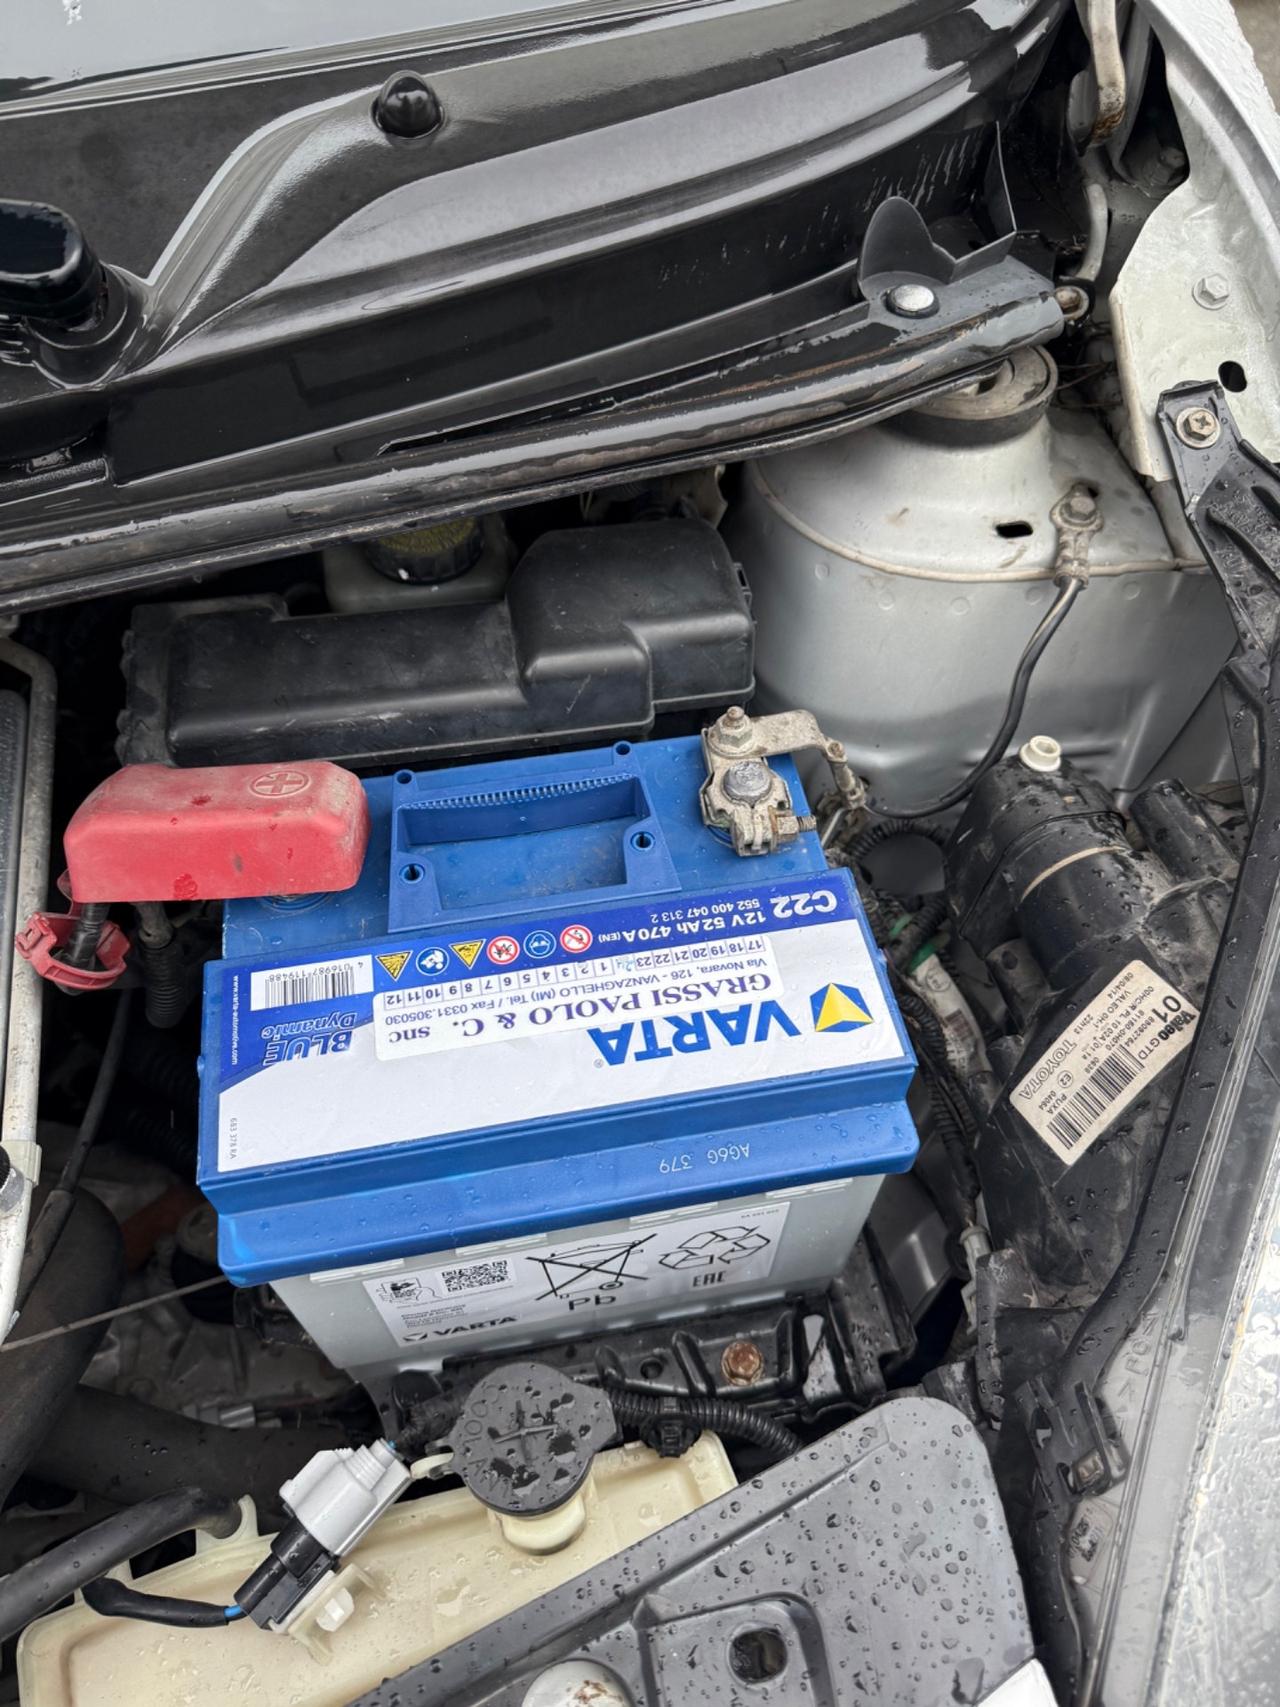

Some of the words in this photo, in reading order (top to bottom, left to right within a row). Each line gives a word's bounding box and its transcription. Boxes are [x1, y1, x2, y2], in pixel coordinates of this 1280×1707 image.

[712, 902, 734, 913] 400
[737, 898, 760, 909] 552
[769, 889, 838, 919] C22
[661, 910, 684, 921] 313
[687, 906, 709, 917] 047
[651, 913, 658, 923] 2
[732, 910, 767, 926] 12V
[710, 945, 725, 956] 19
[729, 941, 744, 953] 18
[748, 939, 763, 950] 17
[655, 952, 671, 964] 22
[675, 950, 689, 961] 21
[692, 947, 708, 958] 20
[601, 962, 607, 972] 1
[636, 955, 652, 967] 23
[698, 959, 743, 974] Novara,
[746, 957, 767, 969] Via
[543, 970, 551, 981] 4
[562, 967, 570, 978] 3
[581, 964, 589, 975] 2
[670, 967, 693, 978] 126
[485, 979, 493, 990] 7
[503, 976, 512, 987] 6
[522, 973, 531, 984] 5
[563, 970, 659, 998] VANZAGHELLO
[449, 985, 457, 996] 9
[464, 982, 473, 994] 8
[654, 973, 771, 1006] GRASSI
[386, 994, 403, 1005] 12
[407, 992, 422, 1003] 11
[425, 989, 441, 1000] 10
[509, 994, 529, 1007] Tel.
[531, 989, 557, 1004] (MI)
[471, 1001, 495, 1014] Fax
[1107, 990, 1131, 1014] VALEO
[529, 992, 641, 1025] PAOLO
[1118, 1008, 1131, 1021] PL
[1152, 995, 1181, 1023] 01
[385, 1004, 468, 1026] 0331.305030
[261, 1012, 358, 1040] Dynamic
[496, 1013, 517, 1030] &
[1161, 1010, 1196, 1041] Valeo
[453, 1018, 485, 1038] C.
[588, 1000, 802, 1066] VARTA
[389, 1026, 431, 1043] snc
[1098, 1026, 1114, 1043] 02A
[262, 1031, 352, 1066] BLUE
[1138, 1036, 1161, 1060] GTD
[1018, 1039, 1077, 1100] TOYOTA
[1059, 1074, 1072, 1086] E2
[1047, 1094, 1067, 1115] PUXA
[568, 1293, 618, 1312] Pb
[433, 1313, 516, 1338] VARTA
